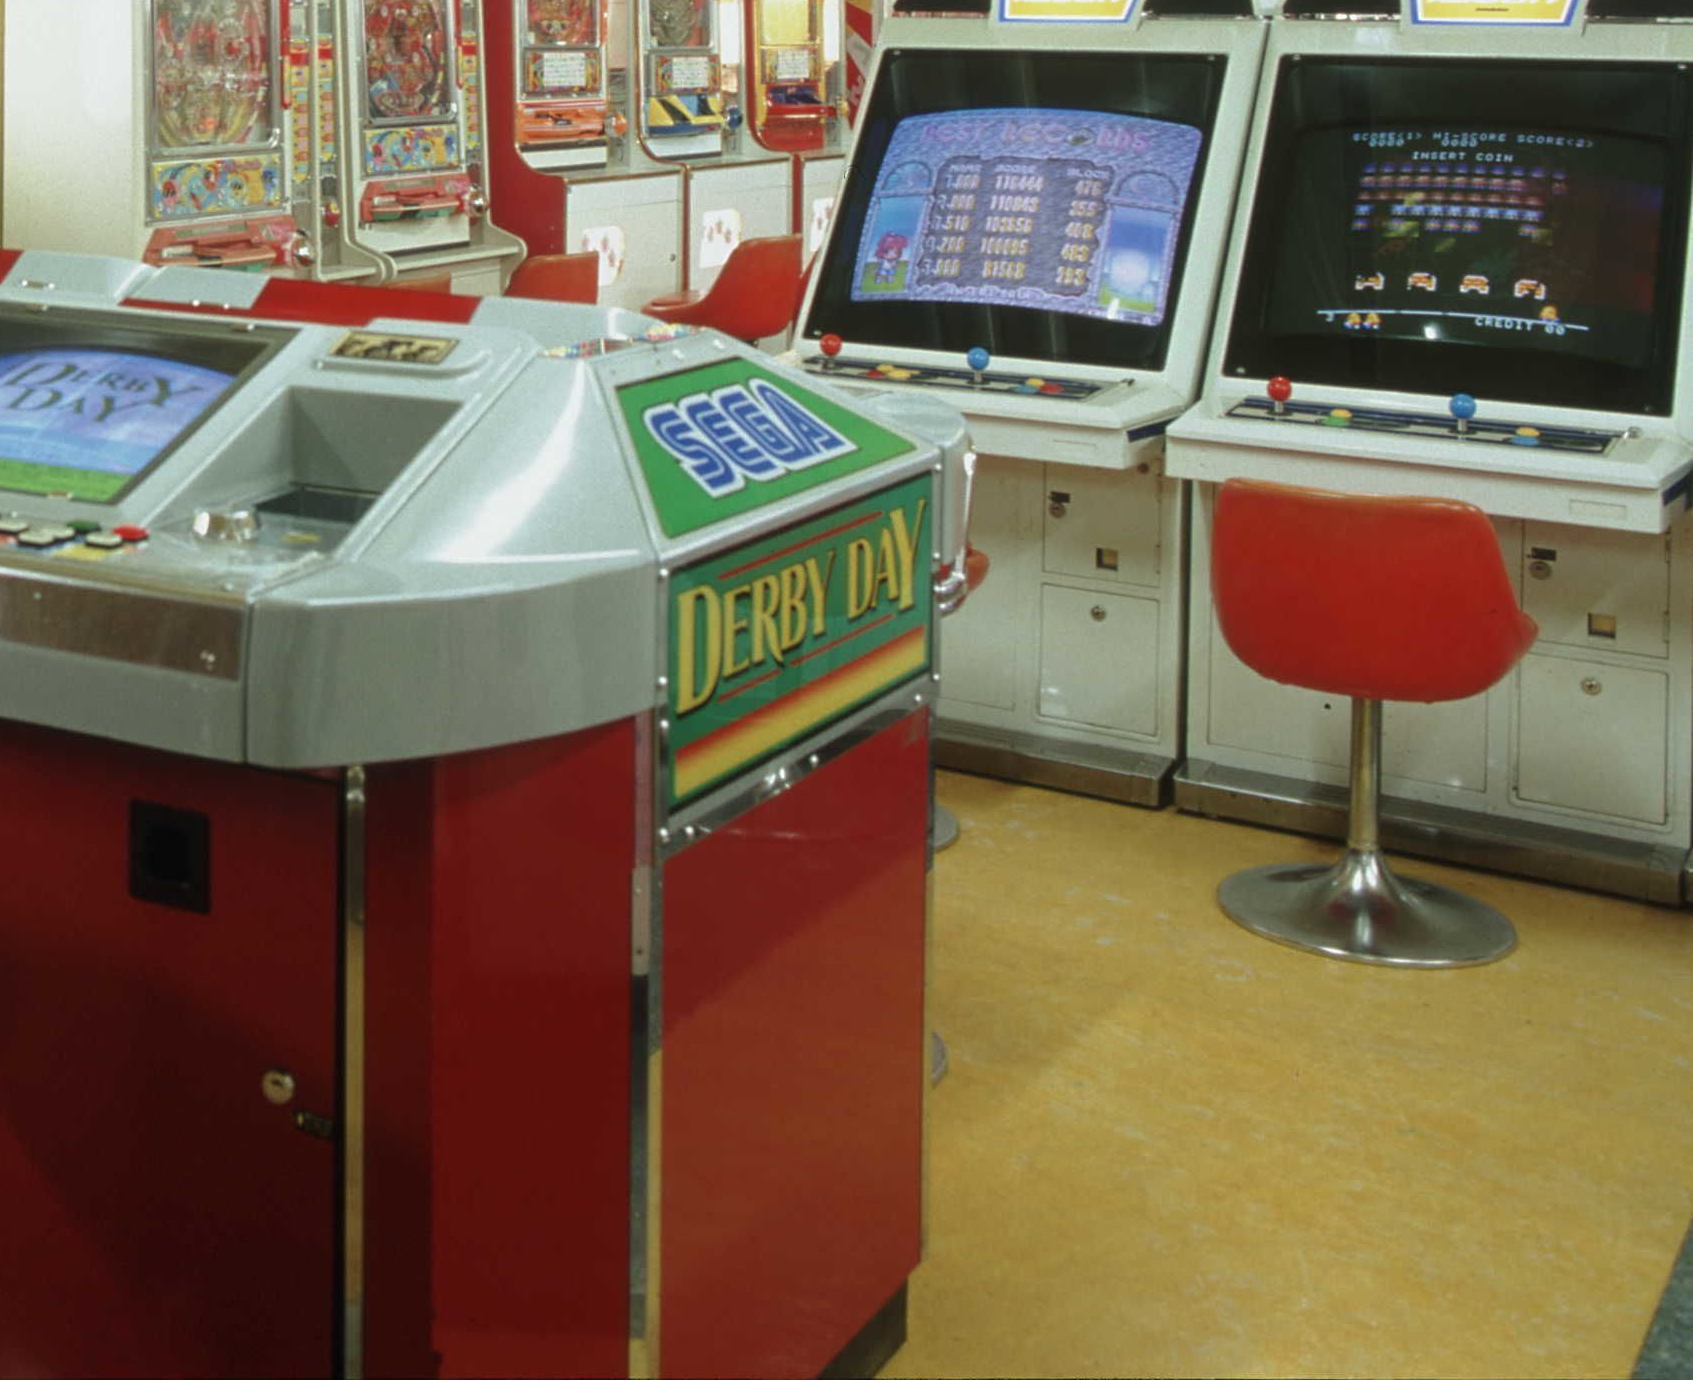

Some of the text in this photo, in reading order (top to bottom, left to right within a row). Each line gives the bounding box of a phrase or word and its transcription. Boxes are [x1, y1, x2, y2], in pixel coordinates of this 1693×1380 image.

[1432, 132, 1507, 142] HI-SCORE
[1411, 150, 1514, 163] INSERT COIN
[1475, 316, 1533, 331] CREDIT
[4, 363, 203, 407] DERBY
[8, 387, 148, 422] DAY
[644, 379, 857, 498] SEGA
[675, 498, 926, 715] DERBY DAY
